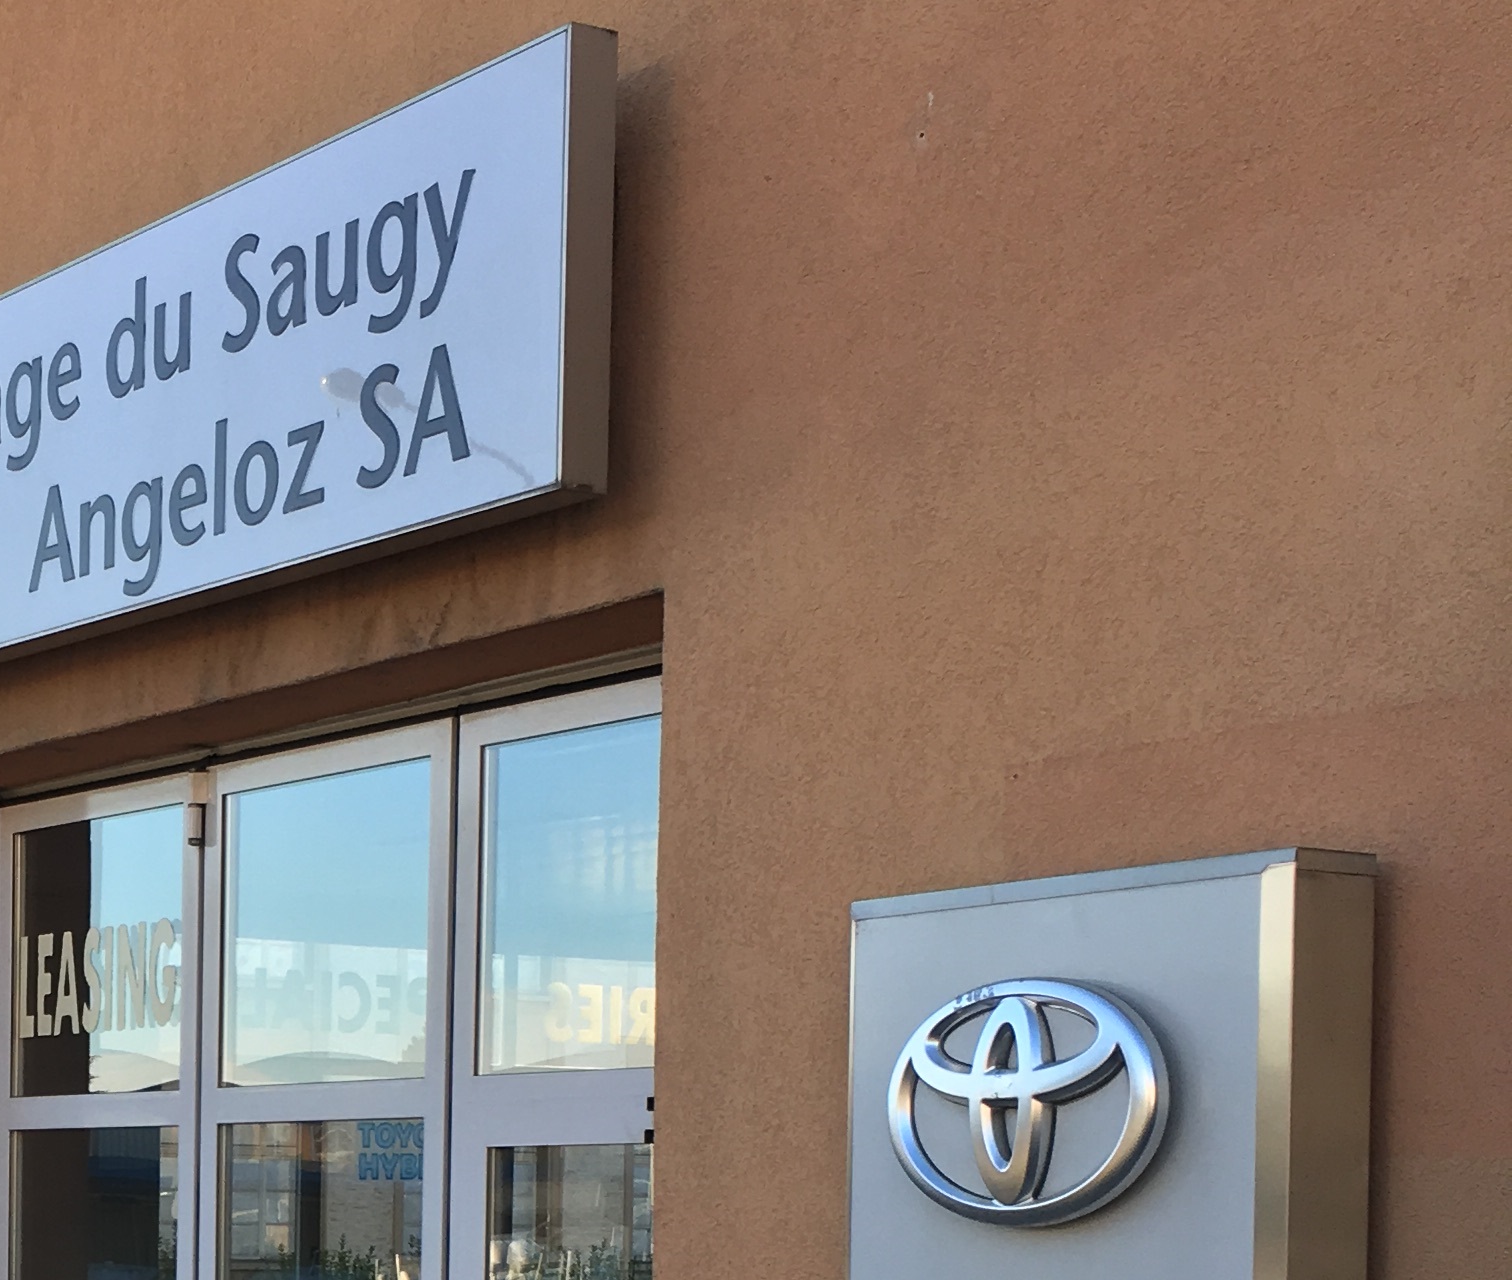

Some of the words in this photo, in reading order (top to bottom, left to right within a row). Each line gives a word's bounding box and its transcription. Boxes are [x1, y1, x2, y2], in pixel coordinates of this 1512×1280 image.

[105, 276, 192, 398] du
[221, 168, 476, 354] Saugy
[28, 418, 325, 597] Angeloz
[356, 343, 471, 490] SA
[19, 917, 177, 1039] LEASING
[358, 1152, 423, 1180] HYB
